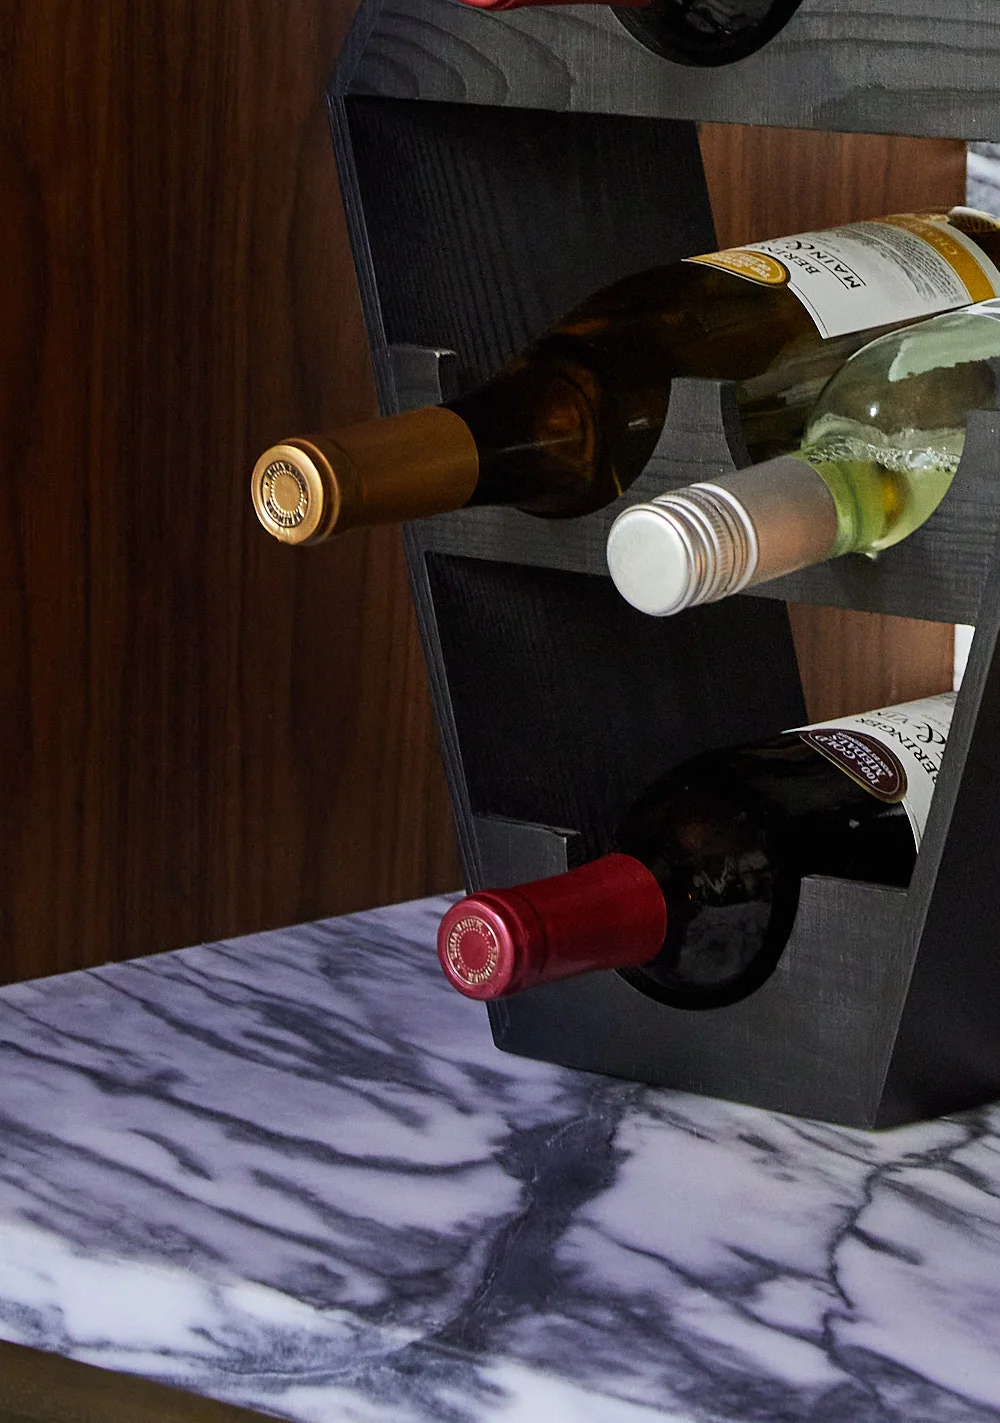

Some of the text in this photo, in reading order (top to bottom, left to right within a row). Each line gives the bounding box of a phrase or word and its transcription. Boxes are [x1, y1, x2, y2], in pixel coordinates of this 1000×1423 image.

[811, 251, 861, 288] MAIN
[815, 735, 856, 759] GOLD
[829, 734, 886, 776] MEDALS
